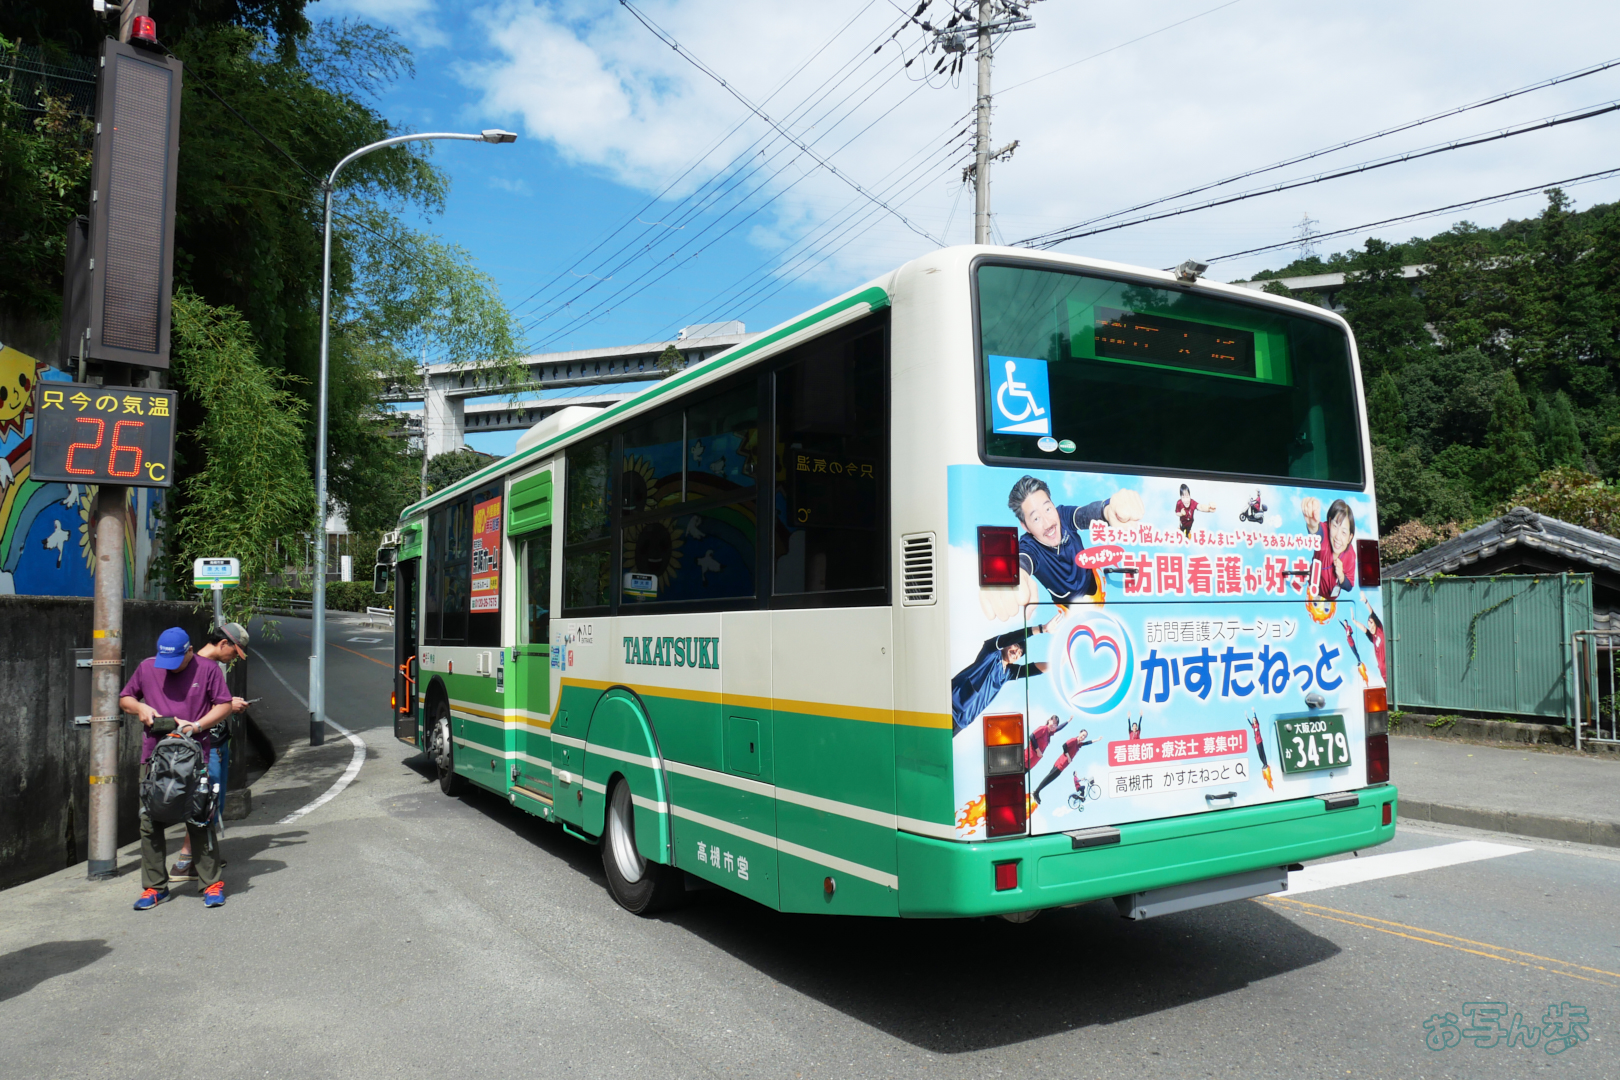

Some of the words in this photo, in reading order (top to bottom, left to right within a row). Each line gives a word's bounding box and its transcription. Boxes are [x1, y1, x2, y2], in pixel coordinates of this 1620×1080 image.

[41, 390, 170, 417] 只今の気温
[65, 416, 145, 477] 26
[1123, 554, 1321, 595] 訪問看護が好き!
[583, 624, 593, 635] 入口
[1147, 620, 1297, 643] 訪問看護ステーション
[623, 636, 720, 670] TAKATSUKI
[1140, 643, 1343, 704] かすたねっと
[1294, 721, 1327, 734] 大阪200
[1113, 738, 1199, 763] 看護師・療法士
[1203, 734, 1243, 754] 募集中!
[1285, 748, 1293, 759] か
[1292, 732, 1348, 768] 34-79
[1115, 774, 1153, 793] 高槻市
[1163, 765, 1230, 787] かすたねっと
[696, 840, 749, 881] 高槻市営
